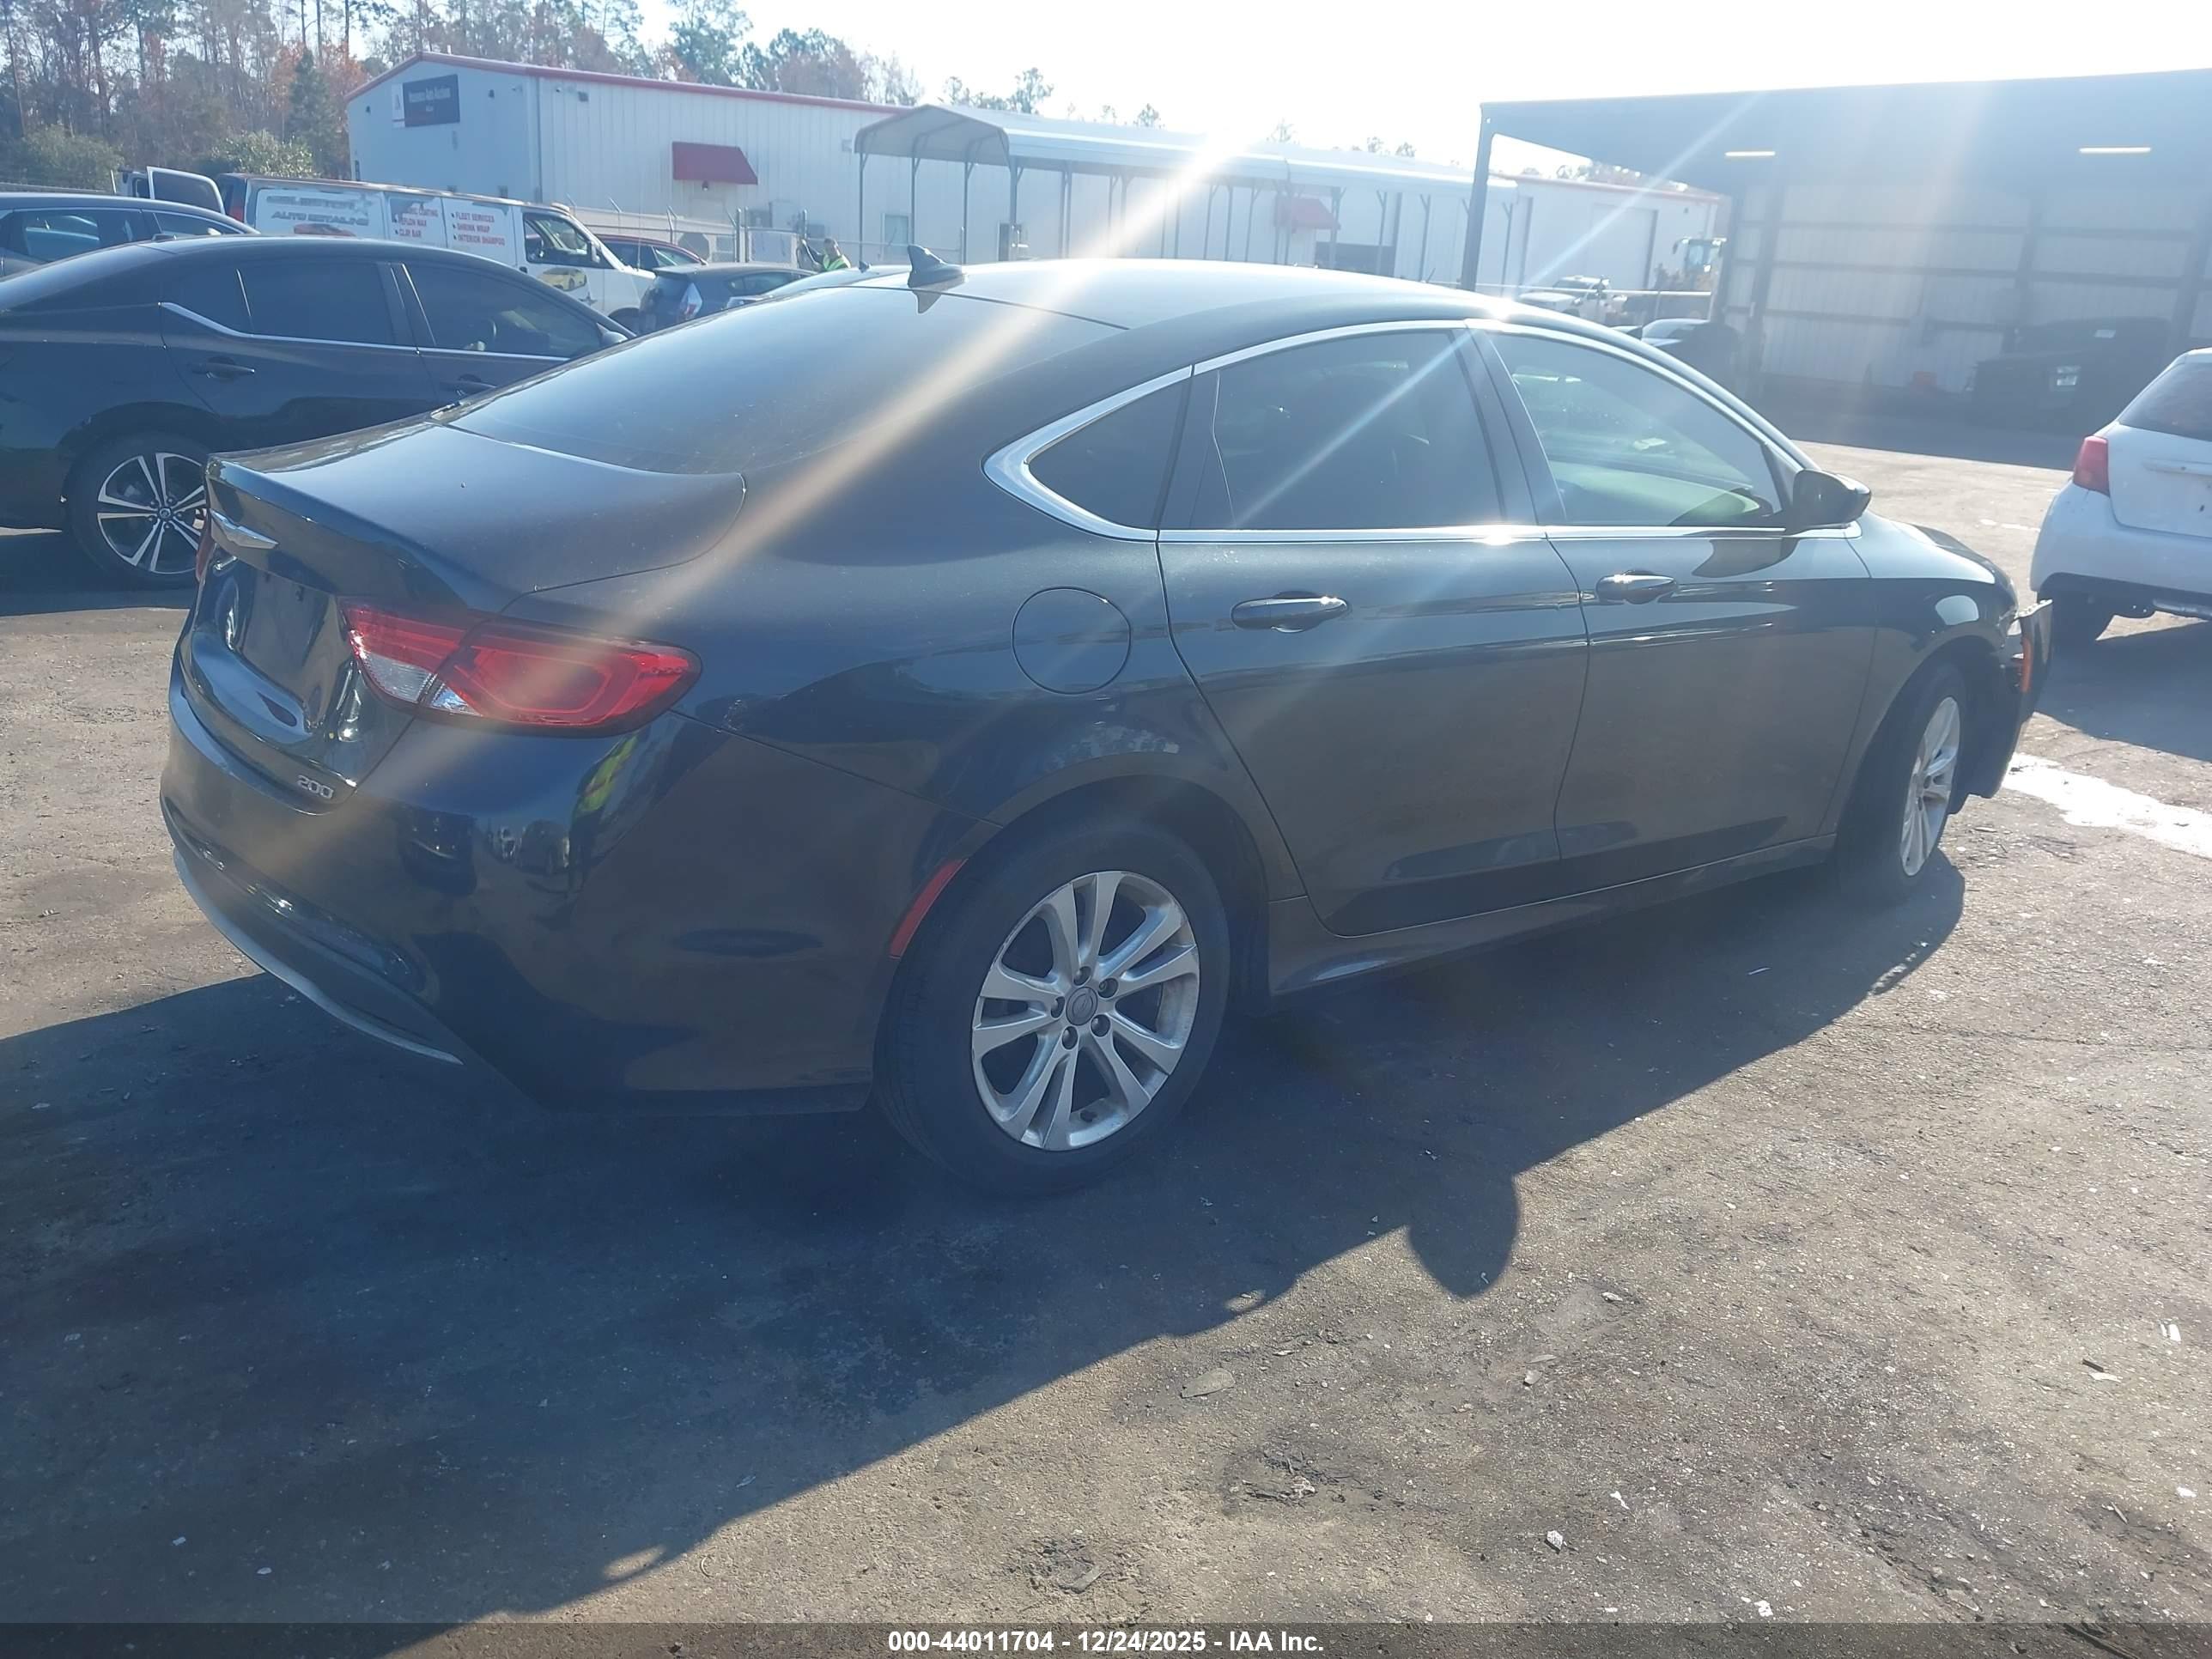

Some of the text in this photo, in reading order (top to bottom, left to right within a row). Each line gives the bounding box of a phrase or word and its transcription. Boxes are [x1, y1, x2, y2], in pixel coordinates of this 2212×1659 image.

[271, 211, 307, 221] AUTO
[455, 211, 495, 223] FLEET SERVICES
[458, 233, 481, 243] INTERIOR
[297, 775, 334, 799] 200
